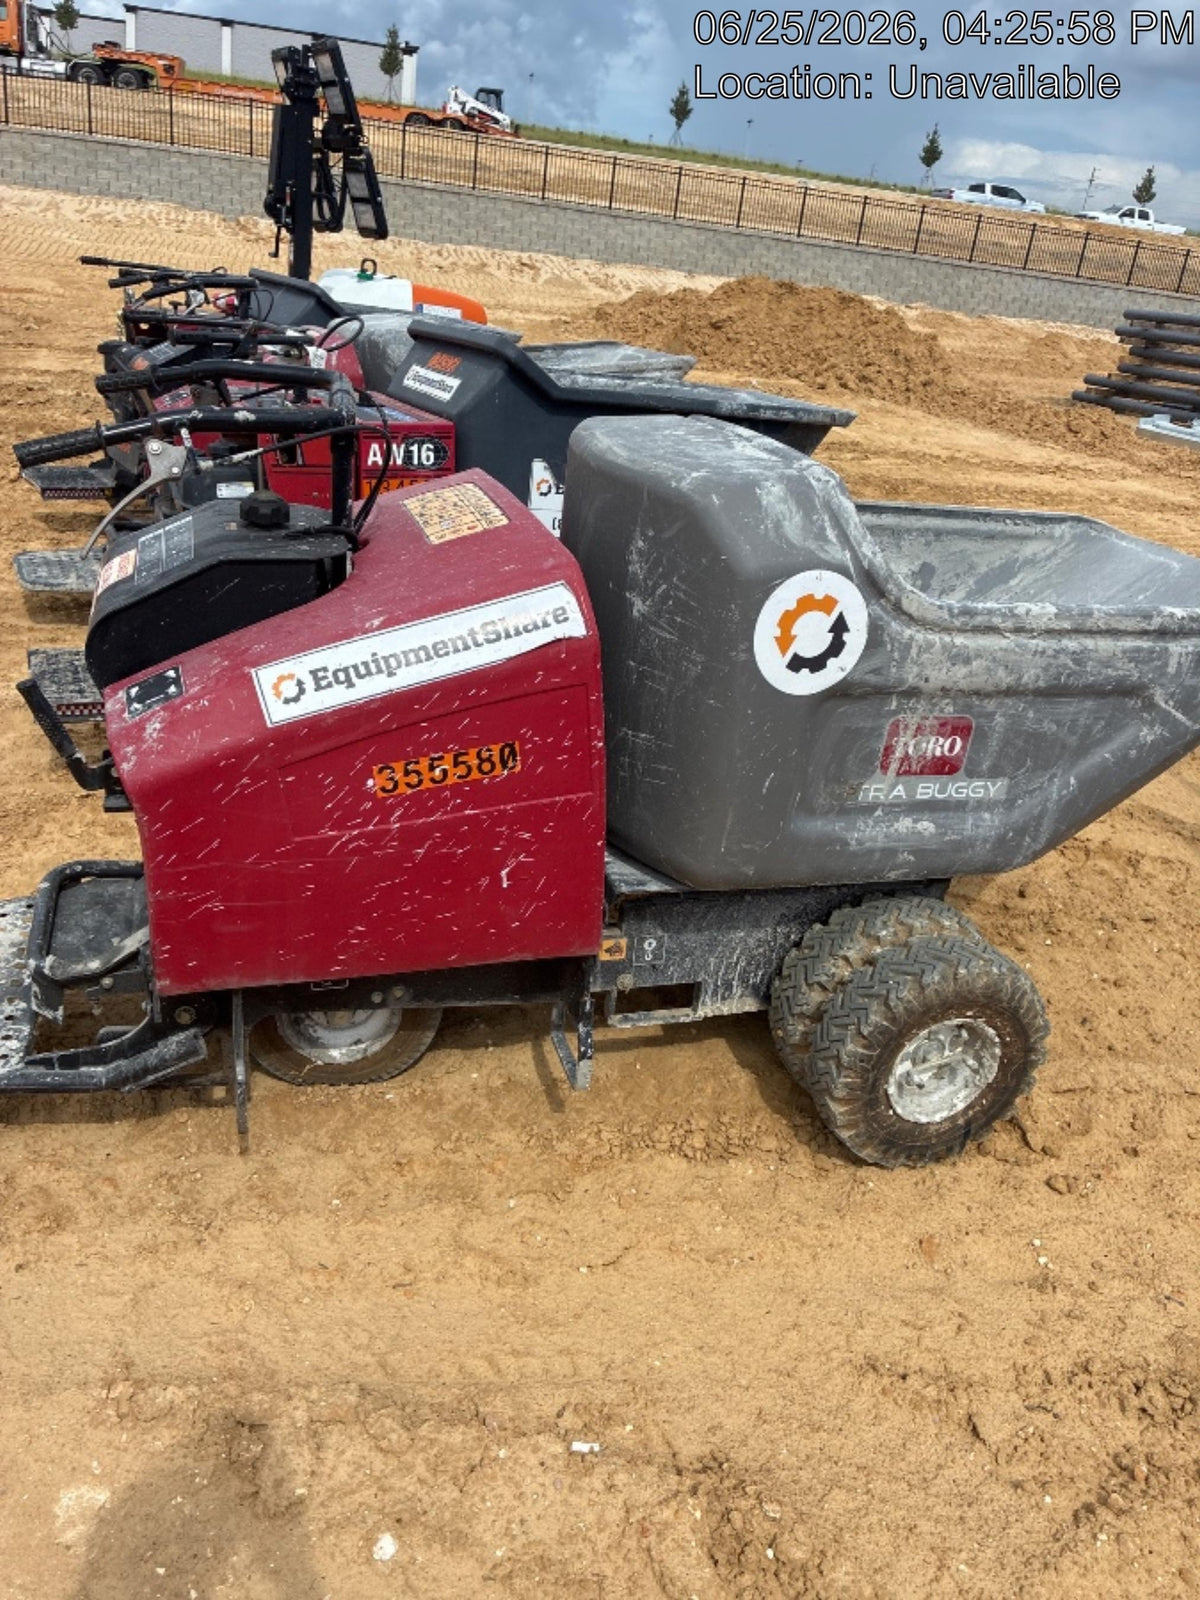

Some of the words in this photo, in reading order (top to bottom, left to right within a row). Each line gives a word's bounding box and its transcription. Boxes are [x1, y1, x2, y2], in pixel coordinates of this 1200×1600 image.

[309, 605, 570, 692] EquipmentShare
[377, 741, 519, 794] 355580
[916, 782, 1002, 799] BUGGY
